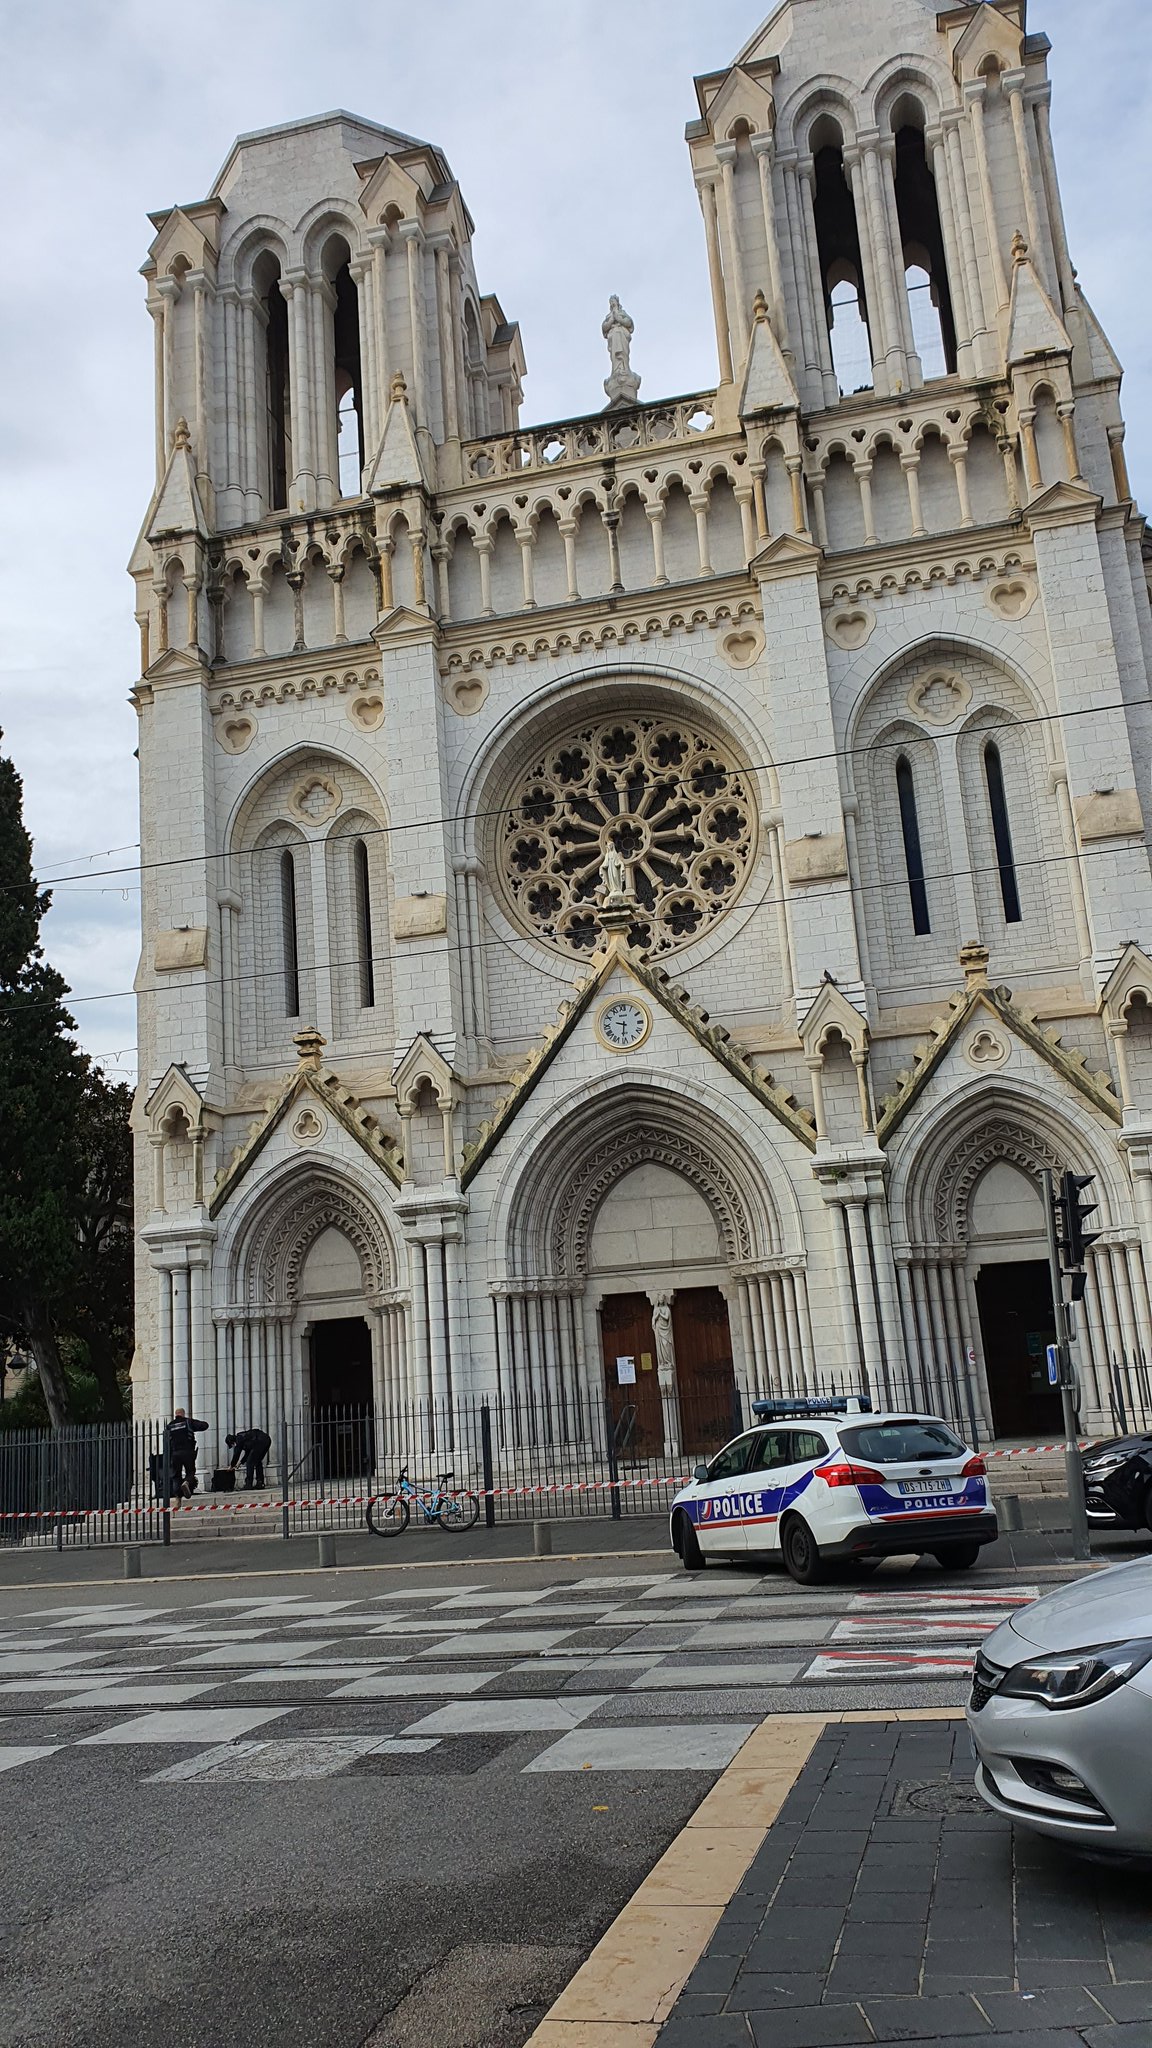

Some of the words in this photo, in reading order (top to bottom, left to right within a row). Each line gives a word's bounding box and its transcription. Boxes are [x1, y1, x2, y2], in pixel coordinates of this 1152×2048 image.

[807, 1397, 831, 1405] POLICE
[713, 1494, 763, 1518] POLICE
[904, 1497, 955, 1509] POLICE
